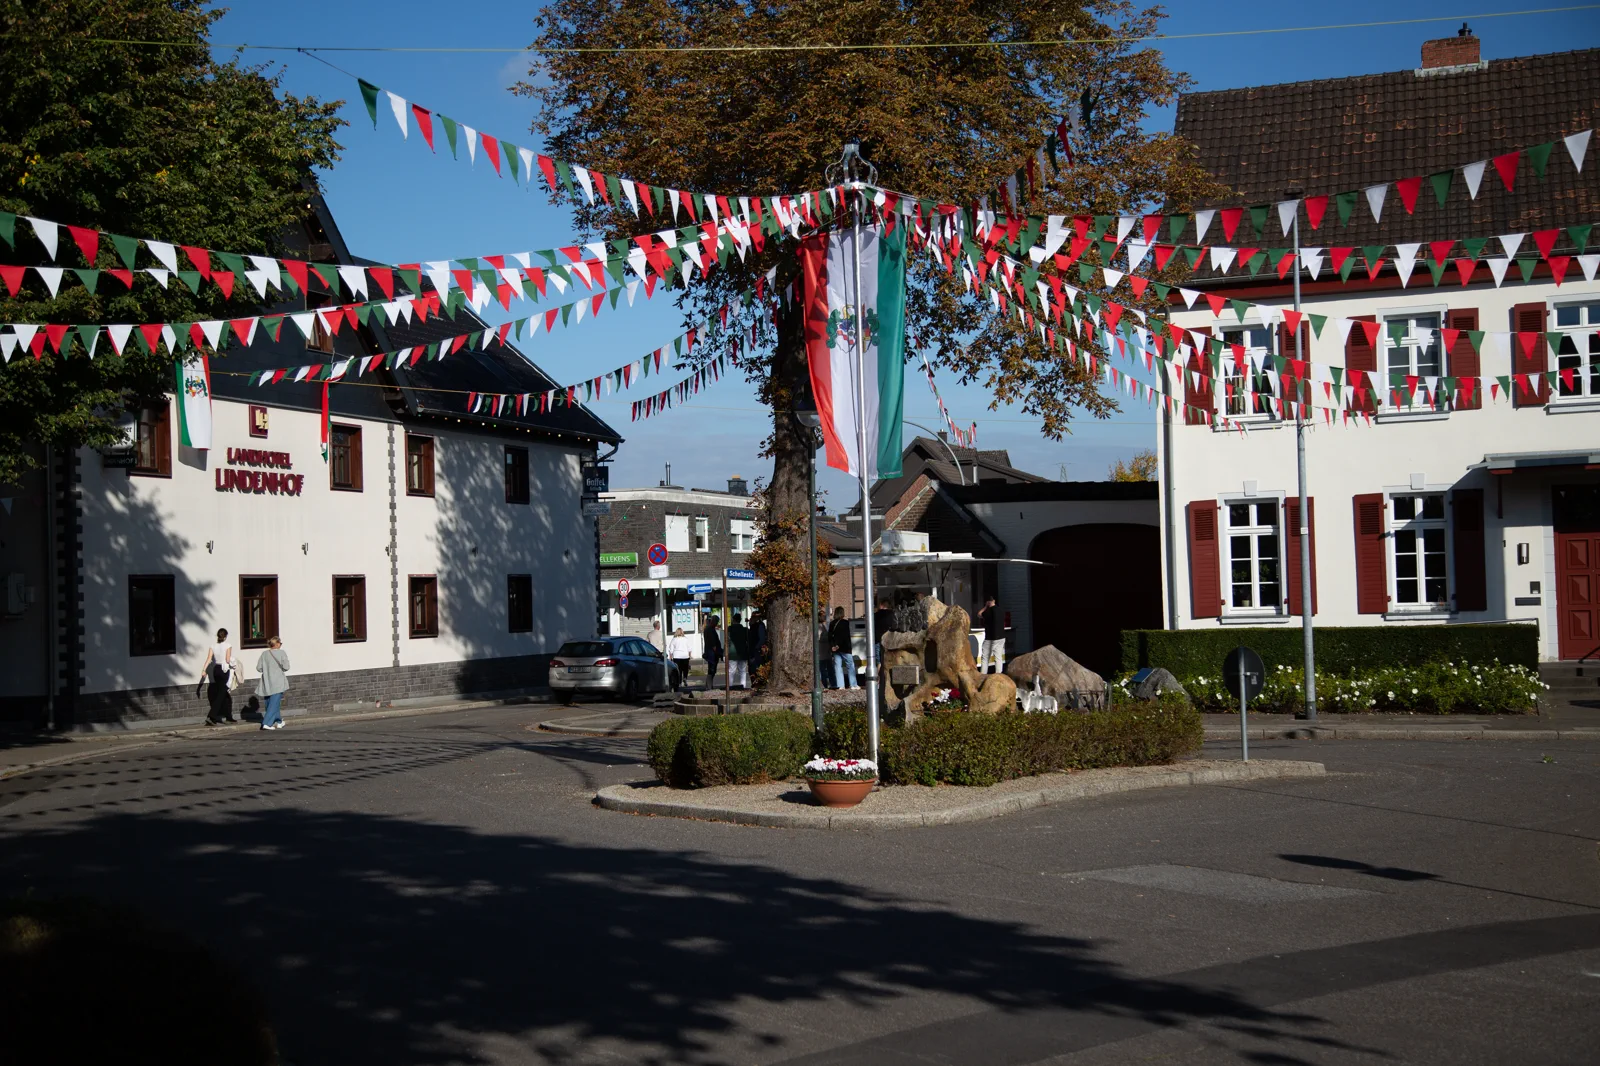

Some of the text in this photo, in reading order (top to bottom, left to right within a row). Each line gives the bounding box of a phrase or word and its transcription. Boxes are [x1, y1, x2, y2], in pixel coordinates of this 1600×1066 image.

[227, 447, 292, 468] LANDHOTEL
[215, 468, 304, 495] LINDENHOF
[586, 477, 605, 487] Gaffel
[620, 582, 628, 592] 30
